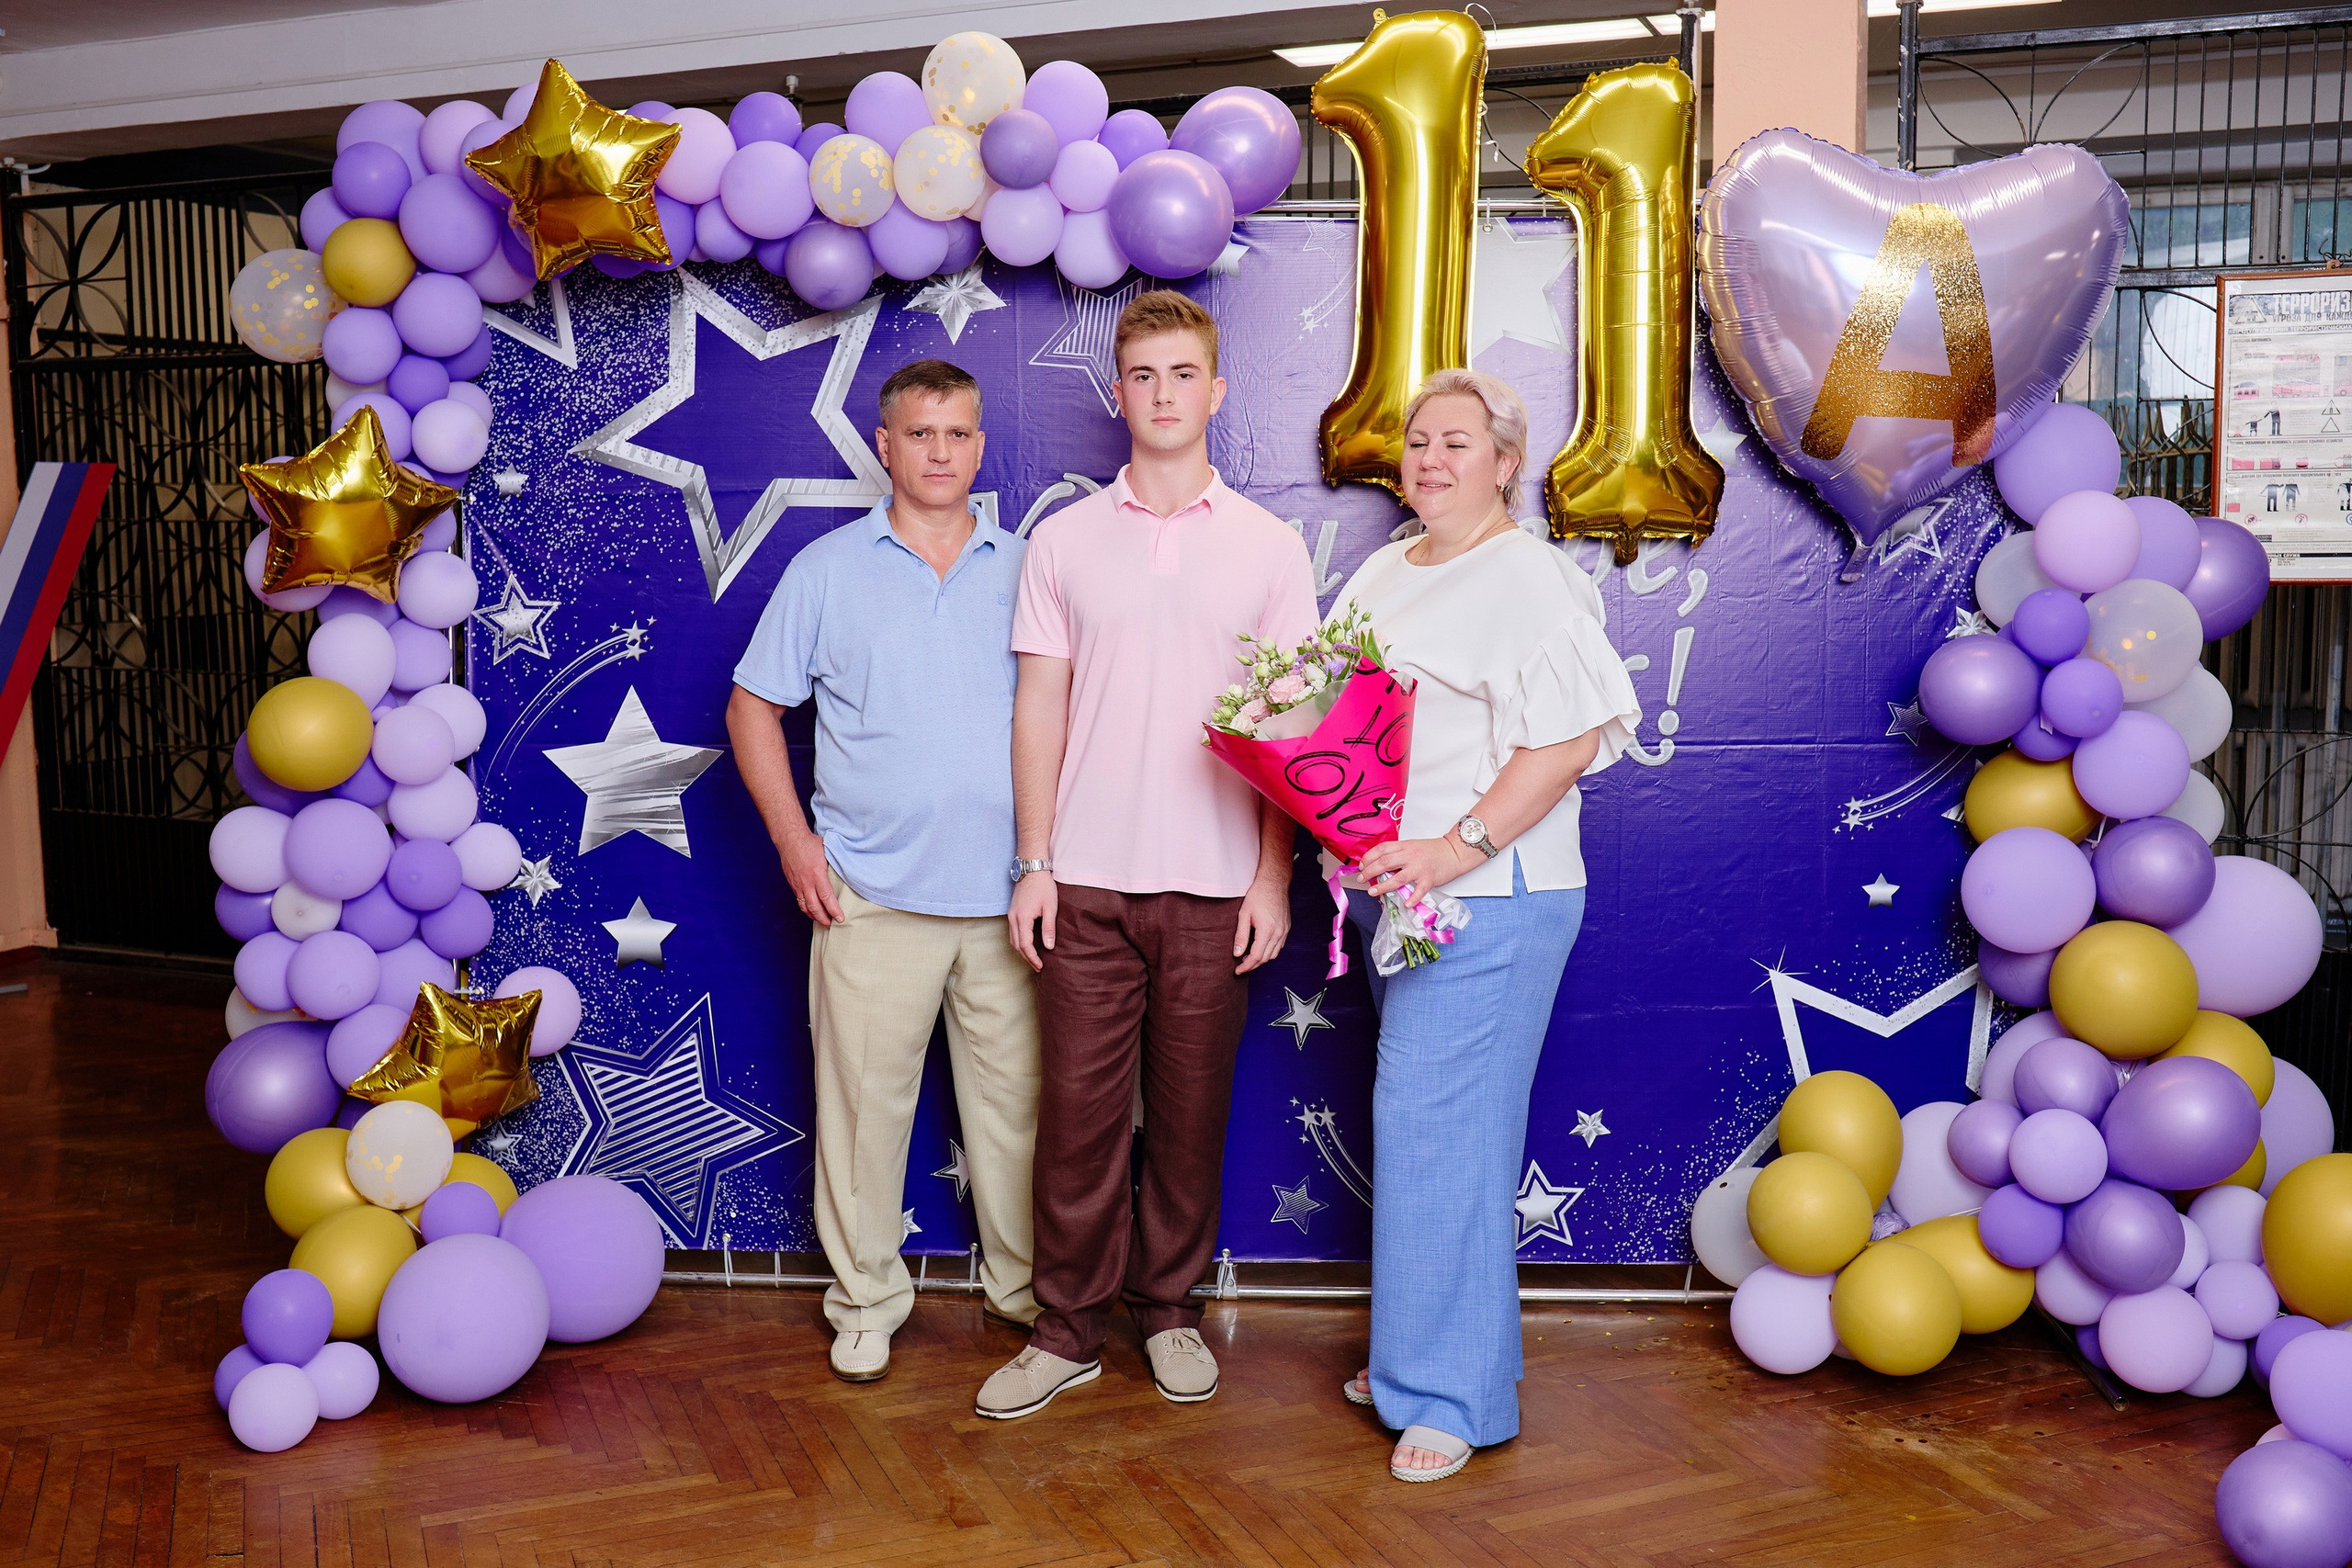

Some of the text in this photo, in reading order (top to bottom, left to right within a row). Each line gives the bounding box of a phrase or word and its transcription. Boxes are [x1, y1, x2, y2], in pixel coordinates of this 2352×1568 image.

[2272, 291, 2352, 314] ТЕРРОРИЗ
[2272, 313, 2301, 323] УГРОЗА
[2304, 313, 2322, 322] ДЛЯ
[1800, 202, 1997, 468] А
